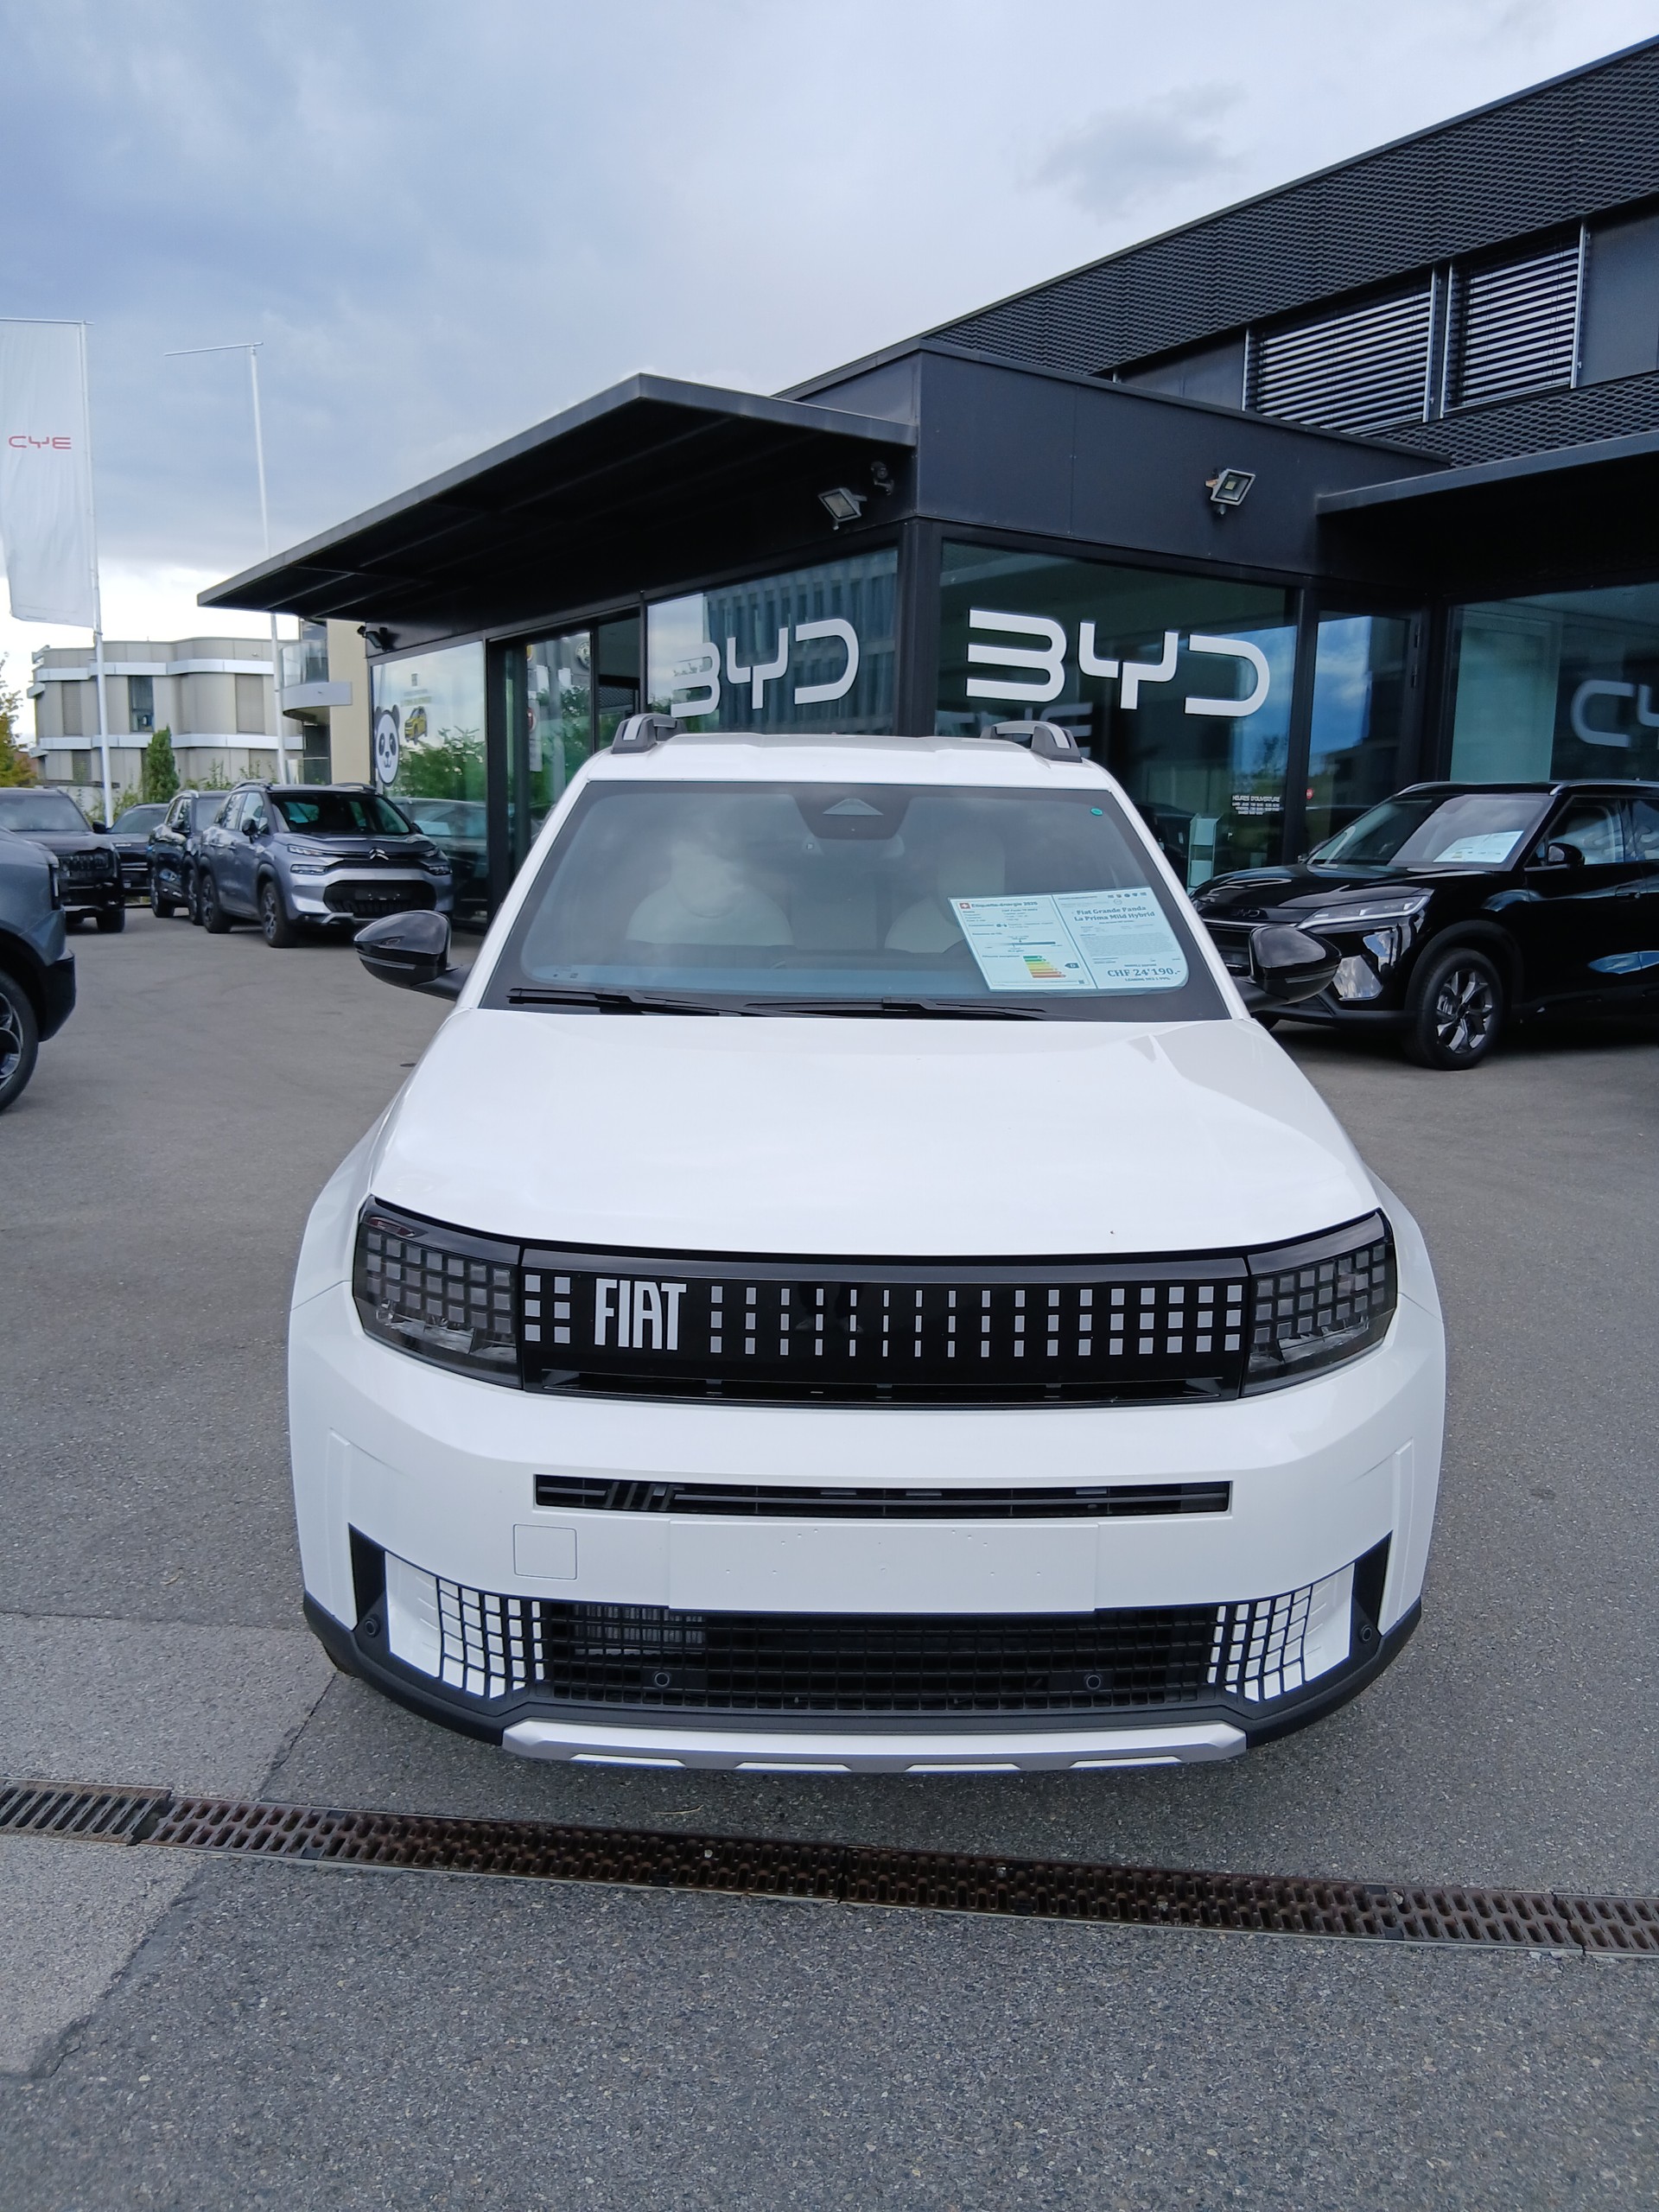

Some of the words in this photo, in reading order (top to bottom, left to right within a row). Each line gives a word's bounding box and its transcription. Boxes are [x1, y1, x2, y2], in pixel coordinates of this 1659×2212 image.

[671, 618, 859, 718] BYD
[966, 607, 1270, 716] BYD
[1128, 911, 1155, 919] Hybrid
[1107, 969, 1130, 977] CHF
[1133, 967, 1181, 976] 24'190.-
[594, 1278, 687, 1351] FIAT
